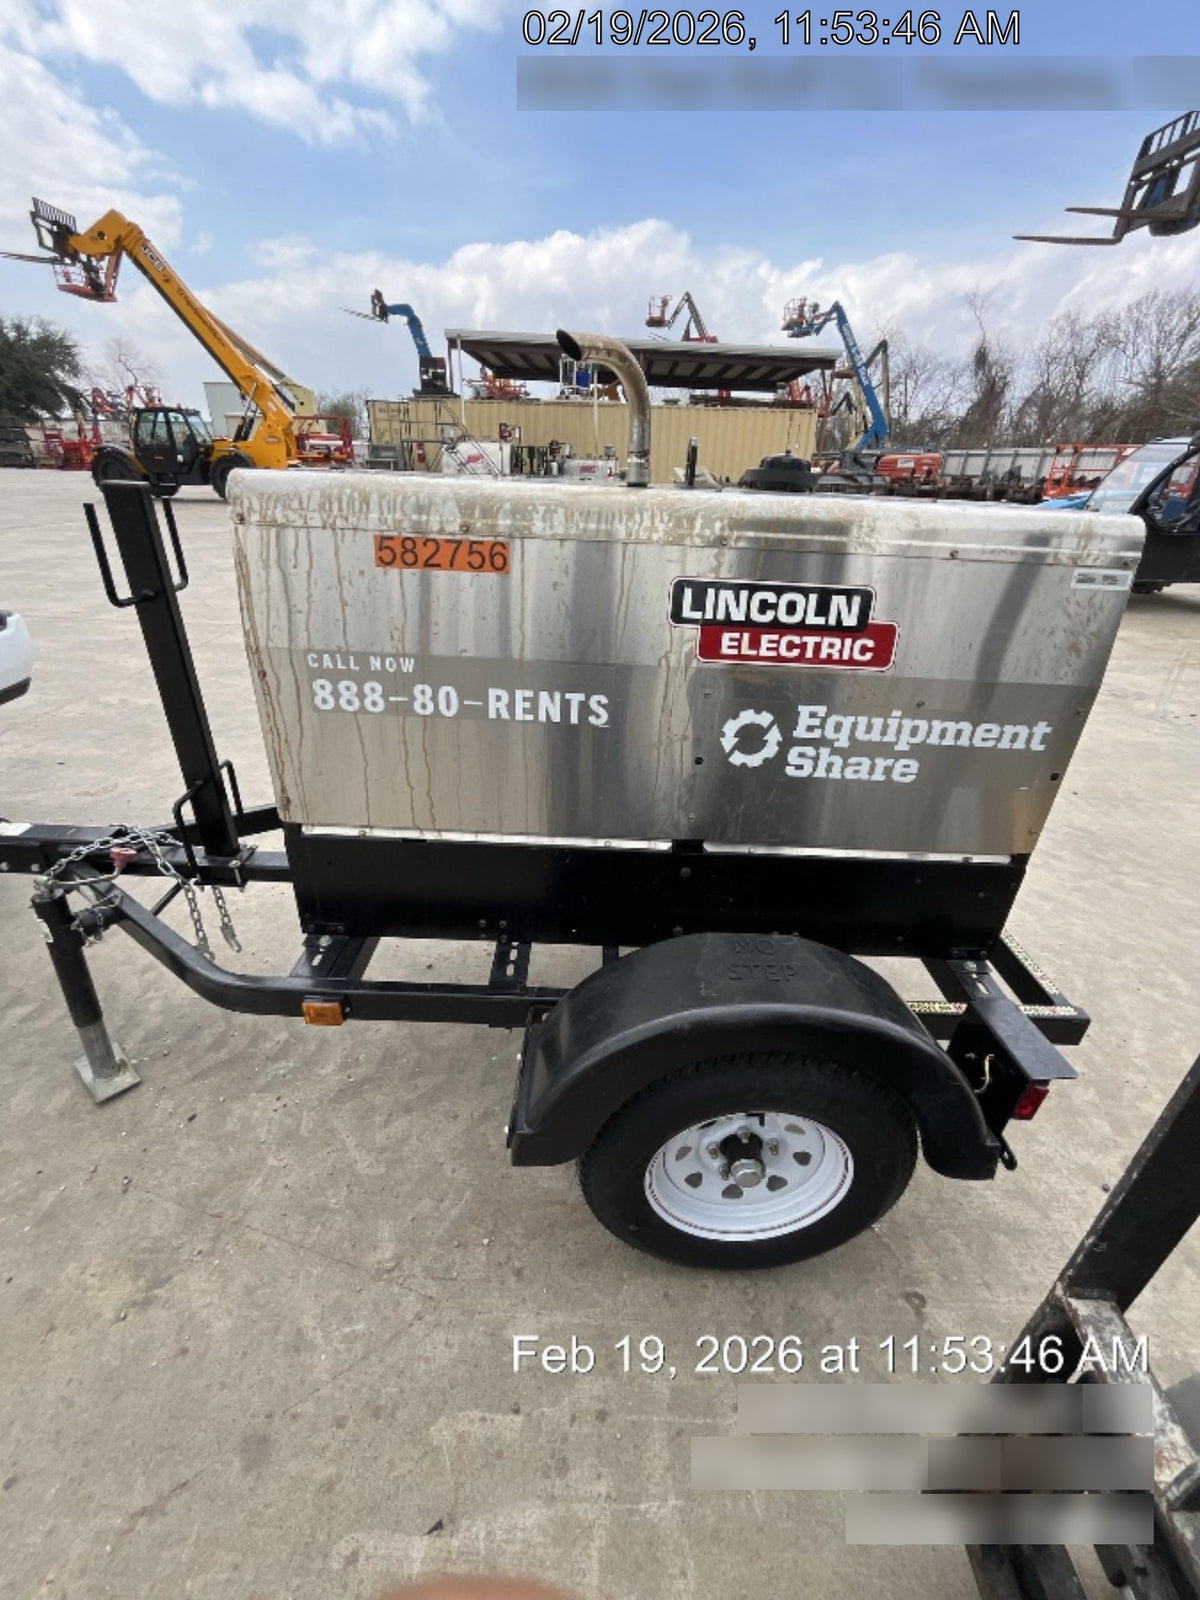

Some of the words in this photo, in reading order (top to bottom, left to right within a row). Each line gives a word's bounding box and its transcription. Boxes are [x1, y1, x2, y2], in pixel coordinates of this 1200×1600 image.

[377, 536, 509, 572] 582756
[681, 586, 861, 627] LINCOLN
[307, 653, 360, 671] CALL
[370, 655, 416, 674] NOW
[720, 632, 876, 662] ELECTRIC
[312, 678, 610, 728] 888-80-RENTS
[792, 704, 1053, 752] Equipment
[785, 745, 920, 783] Share
[734, 936, 776, 955] NO
[728, 963, 800, 983] STEP
